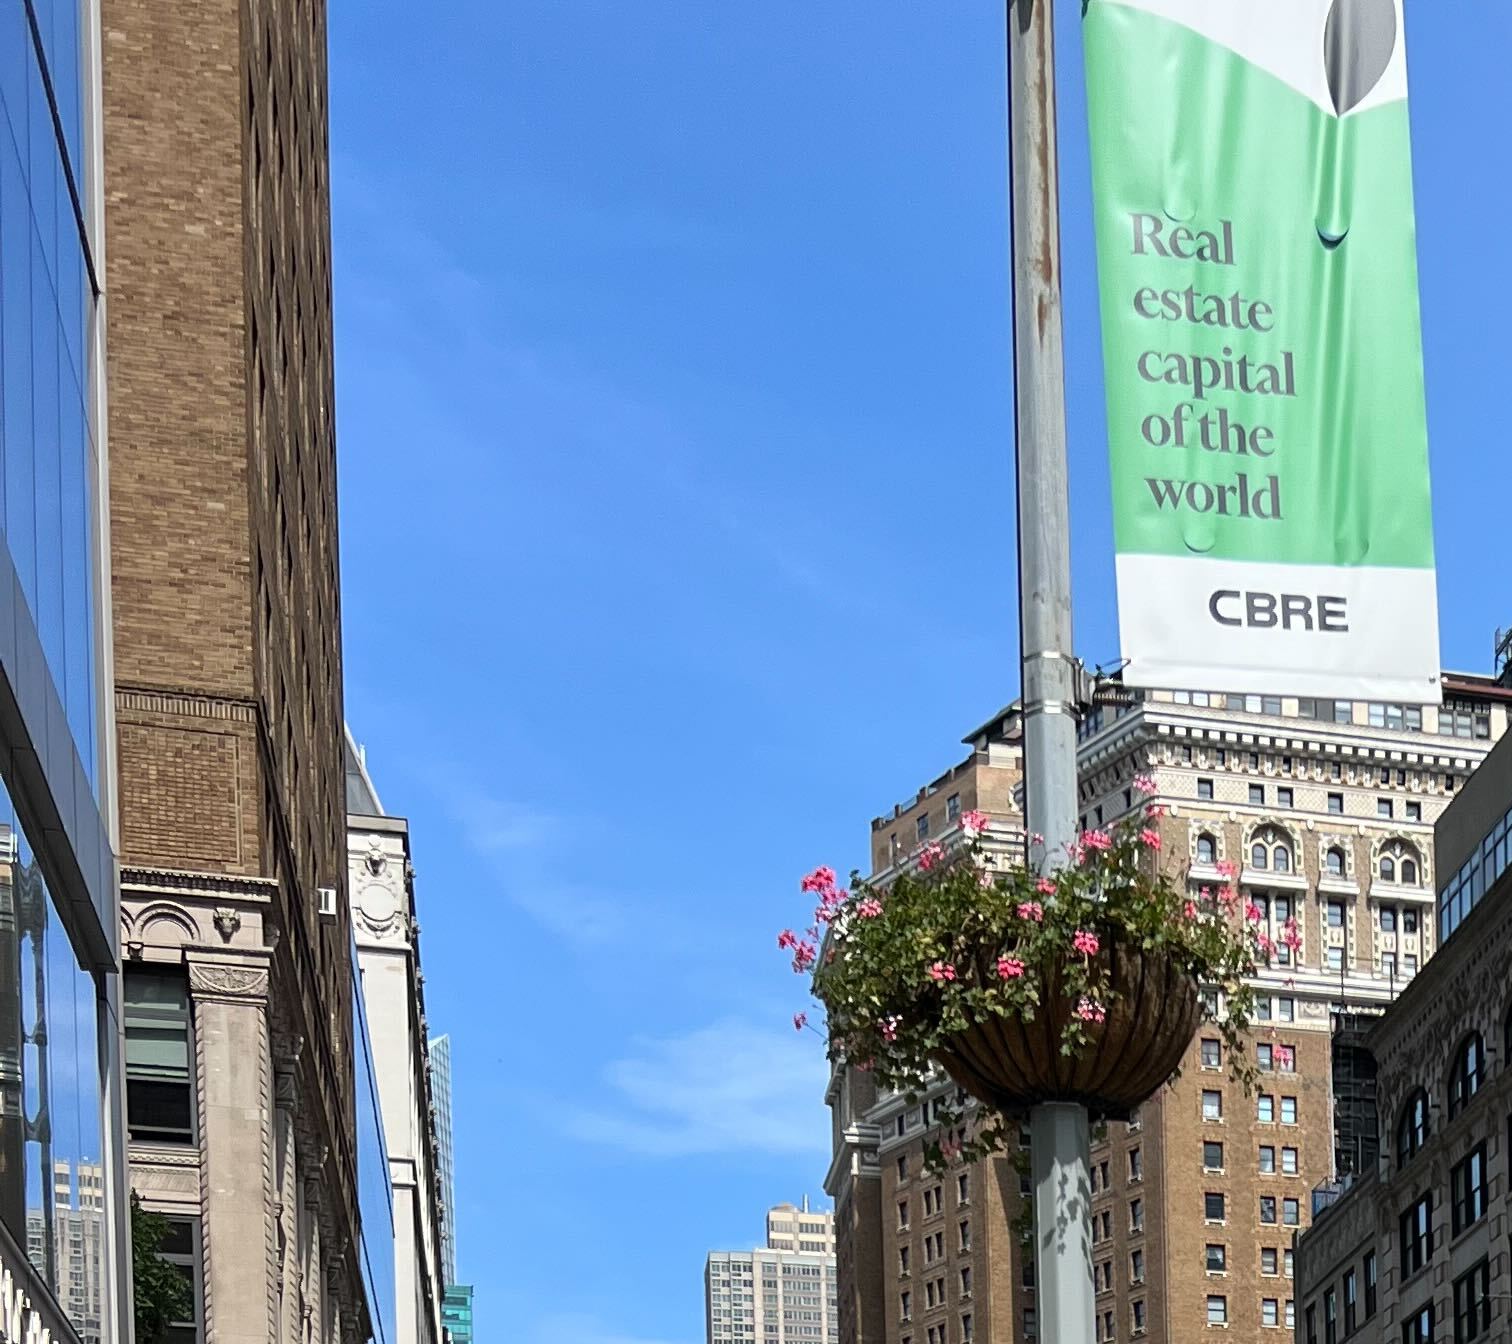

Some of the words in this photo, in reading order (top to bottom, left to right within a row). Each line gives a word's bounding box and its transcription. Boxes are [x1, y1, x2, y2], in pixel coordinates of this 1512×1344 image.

[1129, 212, 1237, 267] Real
[1133, 284, 1275, 333] estate
[1137, 347, 1298, 401] capital
[1141, 403, 1194, 449] of
[1200, 407, 1275, 458] the
[1144, 473, 1284, 521] world
[1208, 589, 1350, 633] CBRE
